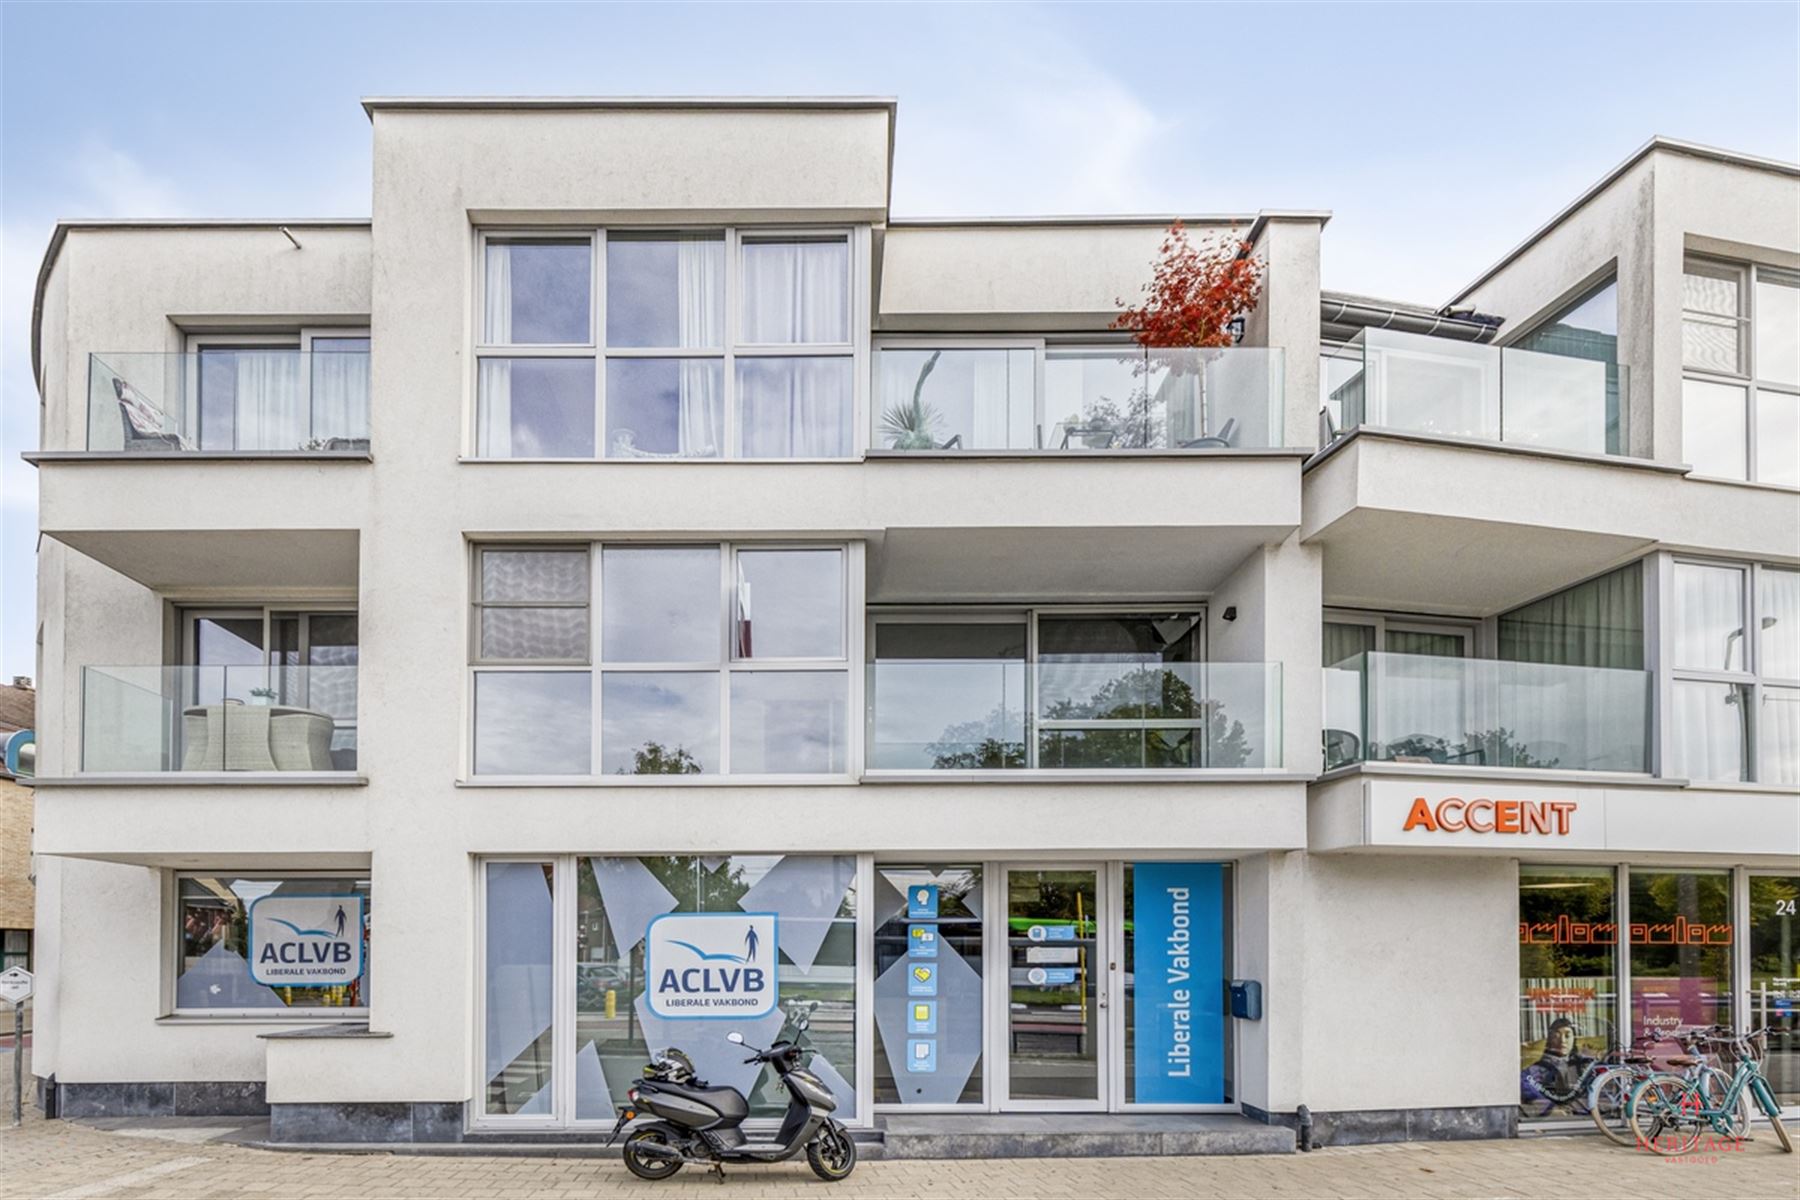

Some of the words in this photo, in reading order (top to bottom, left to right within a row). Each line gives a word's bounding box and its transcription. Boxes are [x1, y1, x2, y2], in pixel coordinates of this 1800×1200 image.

[1403, 797, 1577, 835] ACCENT
[1775, 899, 1797, 916] 24
[1167, 887, 1190, 984] Vakbond
[260, 942, 352, 964] ACLVB
[266, 967, 305, 976] LIBERALE
[306, 967, 346, 975] VAKBOND
[658, 968, 765, 993] ACLVB
[665, 998, 710, 1007] LIBERALE
[712, 998, 759, 1007] VAKBOND
[1167, 989, 1191, 1078] Liberale
[1643, 1015, 1684, 1030] Industry
